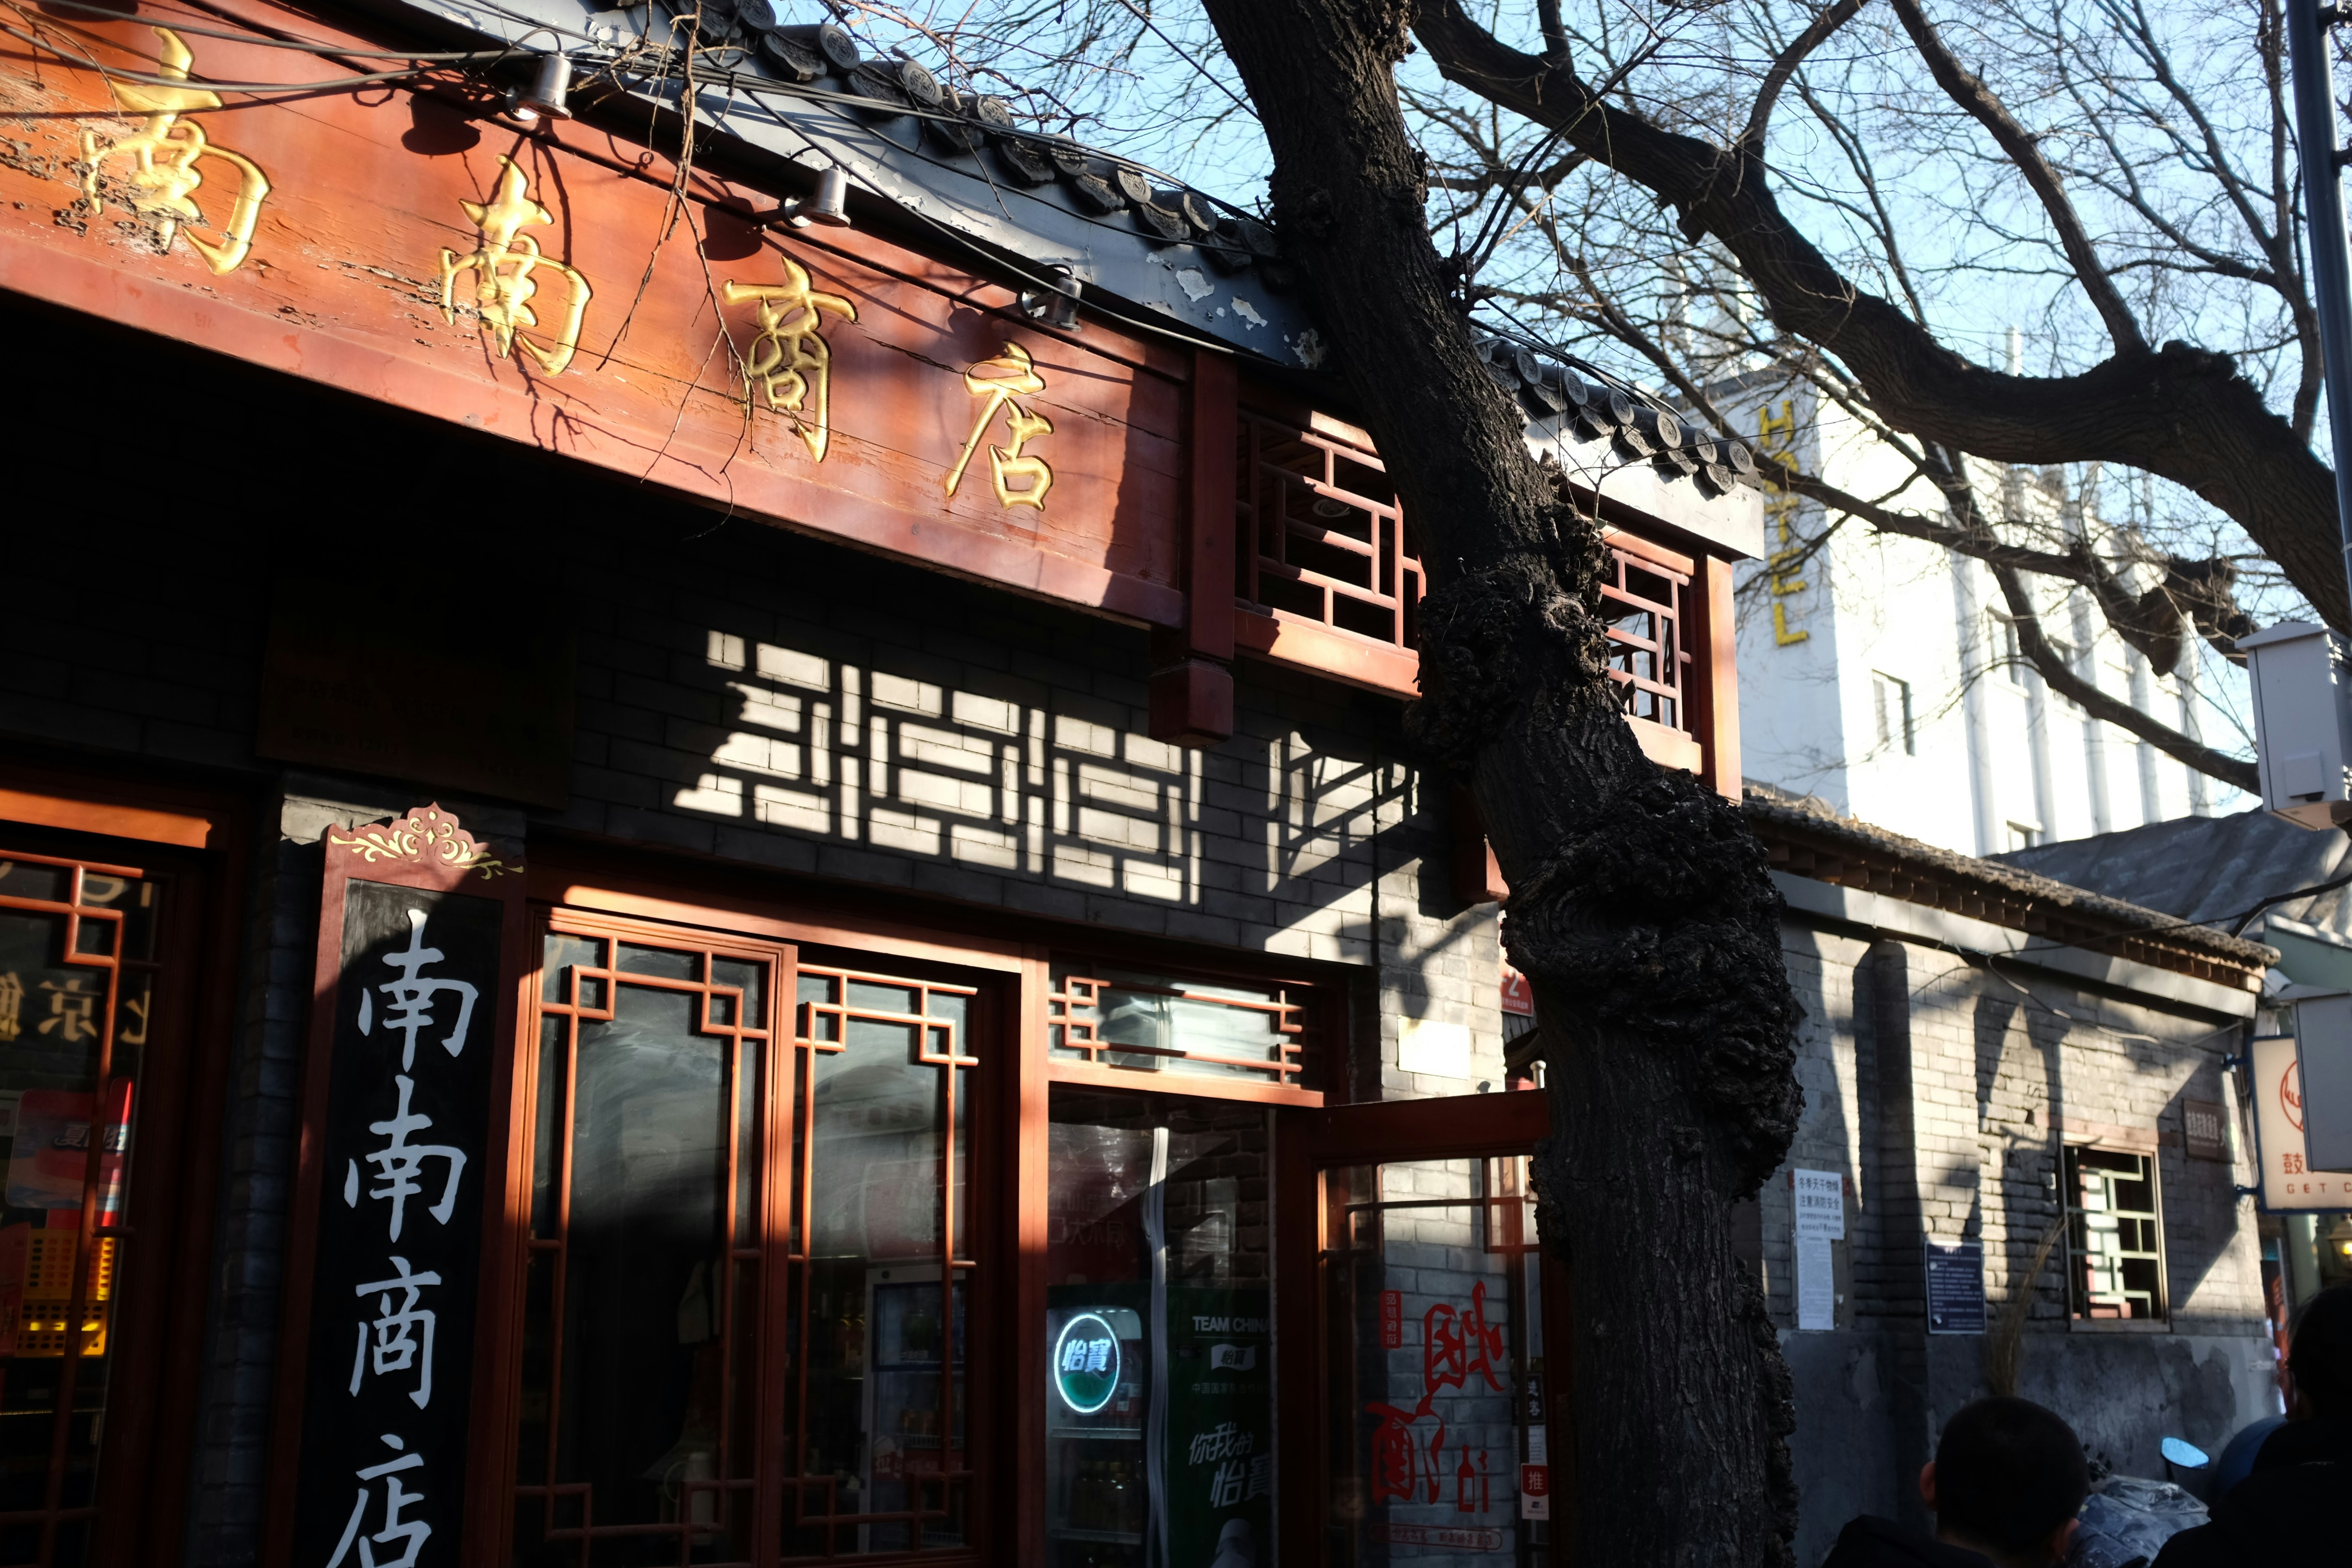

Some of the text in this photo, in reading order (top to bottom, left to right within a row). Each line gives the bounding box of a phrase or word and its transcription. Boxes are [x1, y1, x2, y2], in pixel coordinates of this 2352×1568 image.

[77, 26, 1055, 512] 南南商店
[2282, 1152, 2304, 1175] 鼓
[2287, 1182, 2328, 1194] GET
[326, 908, 478, 1568] 南南商店
[1191, 1315, 1229, 1333] TEAM
[1528, 1470, 1544, 1491] 推
